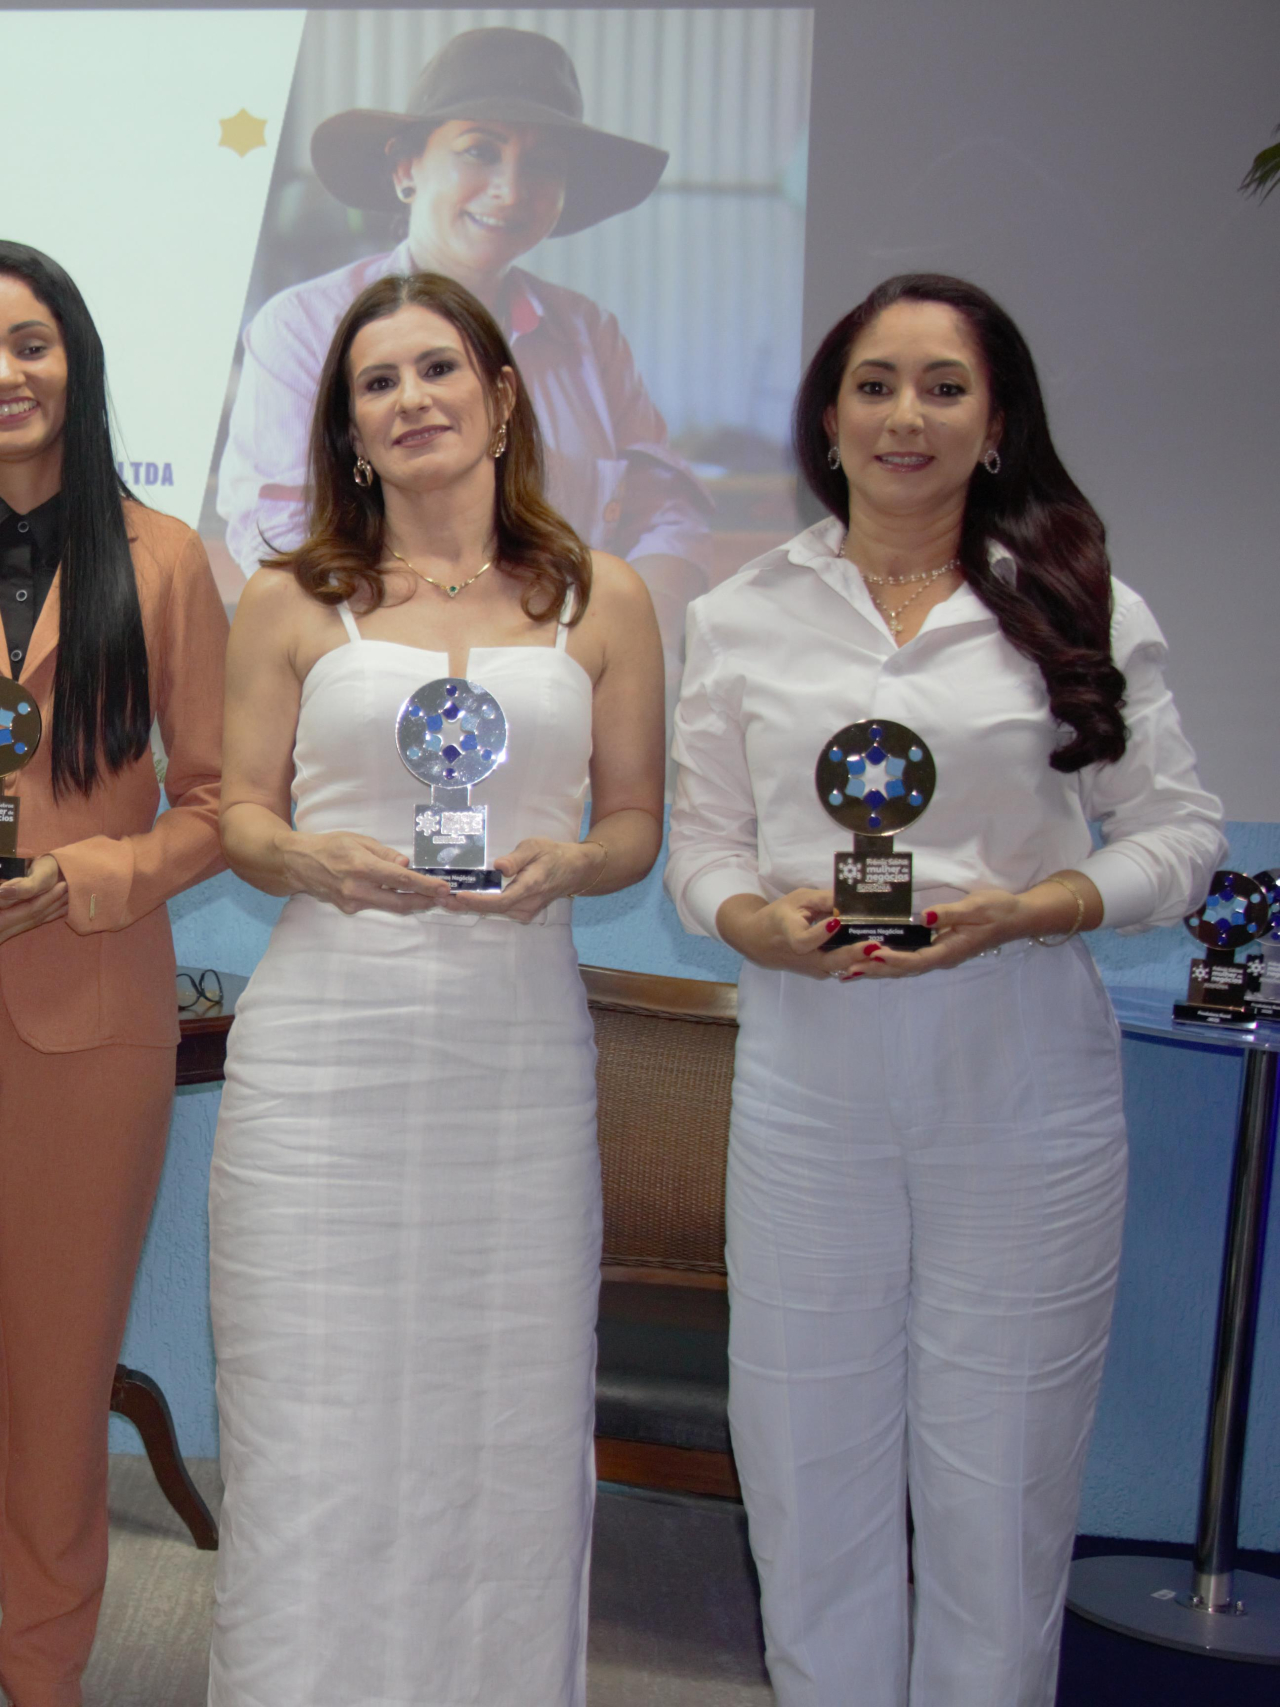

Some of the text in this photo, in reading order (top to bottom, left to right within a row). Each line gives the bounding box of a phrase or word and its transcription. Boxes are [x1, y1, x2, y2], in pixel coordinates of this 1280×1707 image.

[118, 462, 174, 486] LTDA
[866, 865, 900, 873] mulher
[865, 873, 910, 883] negócios
